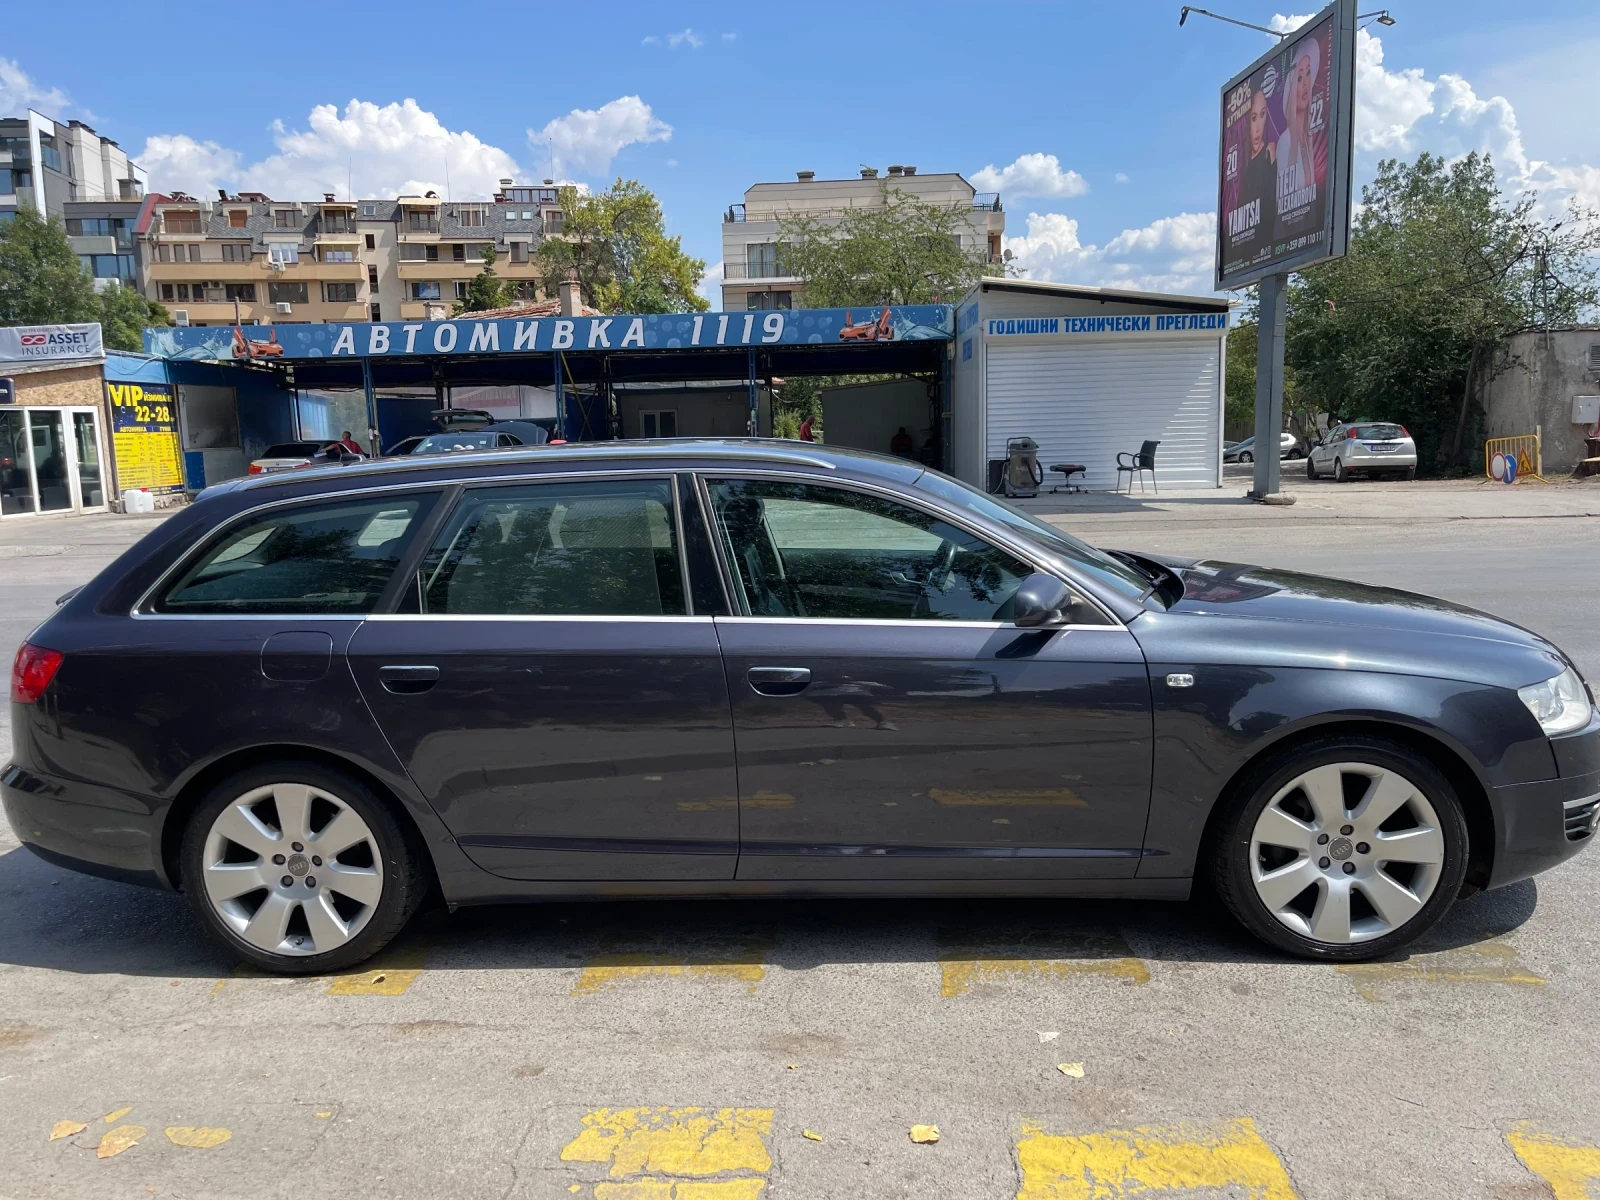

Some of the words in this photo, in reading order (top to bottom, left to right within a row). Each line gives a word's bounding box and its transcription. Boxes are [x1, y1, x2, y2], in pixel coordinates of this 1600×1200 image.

[1227, 78, 1251, 113] -50%
[1310, 99, 1323, 130] 22
[1227, 150, 1238, 176] 20
[1278, 162, 1298, 198] TEDI
[1228, 197, 1261, 237] YANITSA
[1274, 243, 1287, 255] RSVP
[332, 318, 646, 356] АВТОМИВКА
[691, 313, 785, 345] 1119
[989, 318, 1059, 335] ГОДИШНИ
[1064, 316, 1150, 332] ТЕХНИЧЕСКИ
[1156, 314, 1226, 331] ПРЕГЛЕДИ
[21, 344, 91, 356] INSURANCE
[48, 332, 88, 344] ASSET
[109, 384, 144, 407] VIP
[135, 405, 170, 422] 22-28
